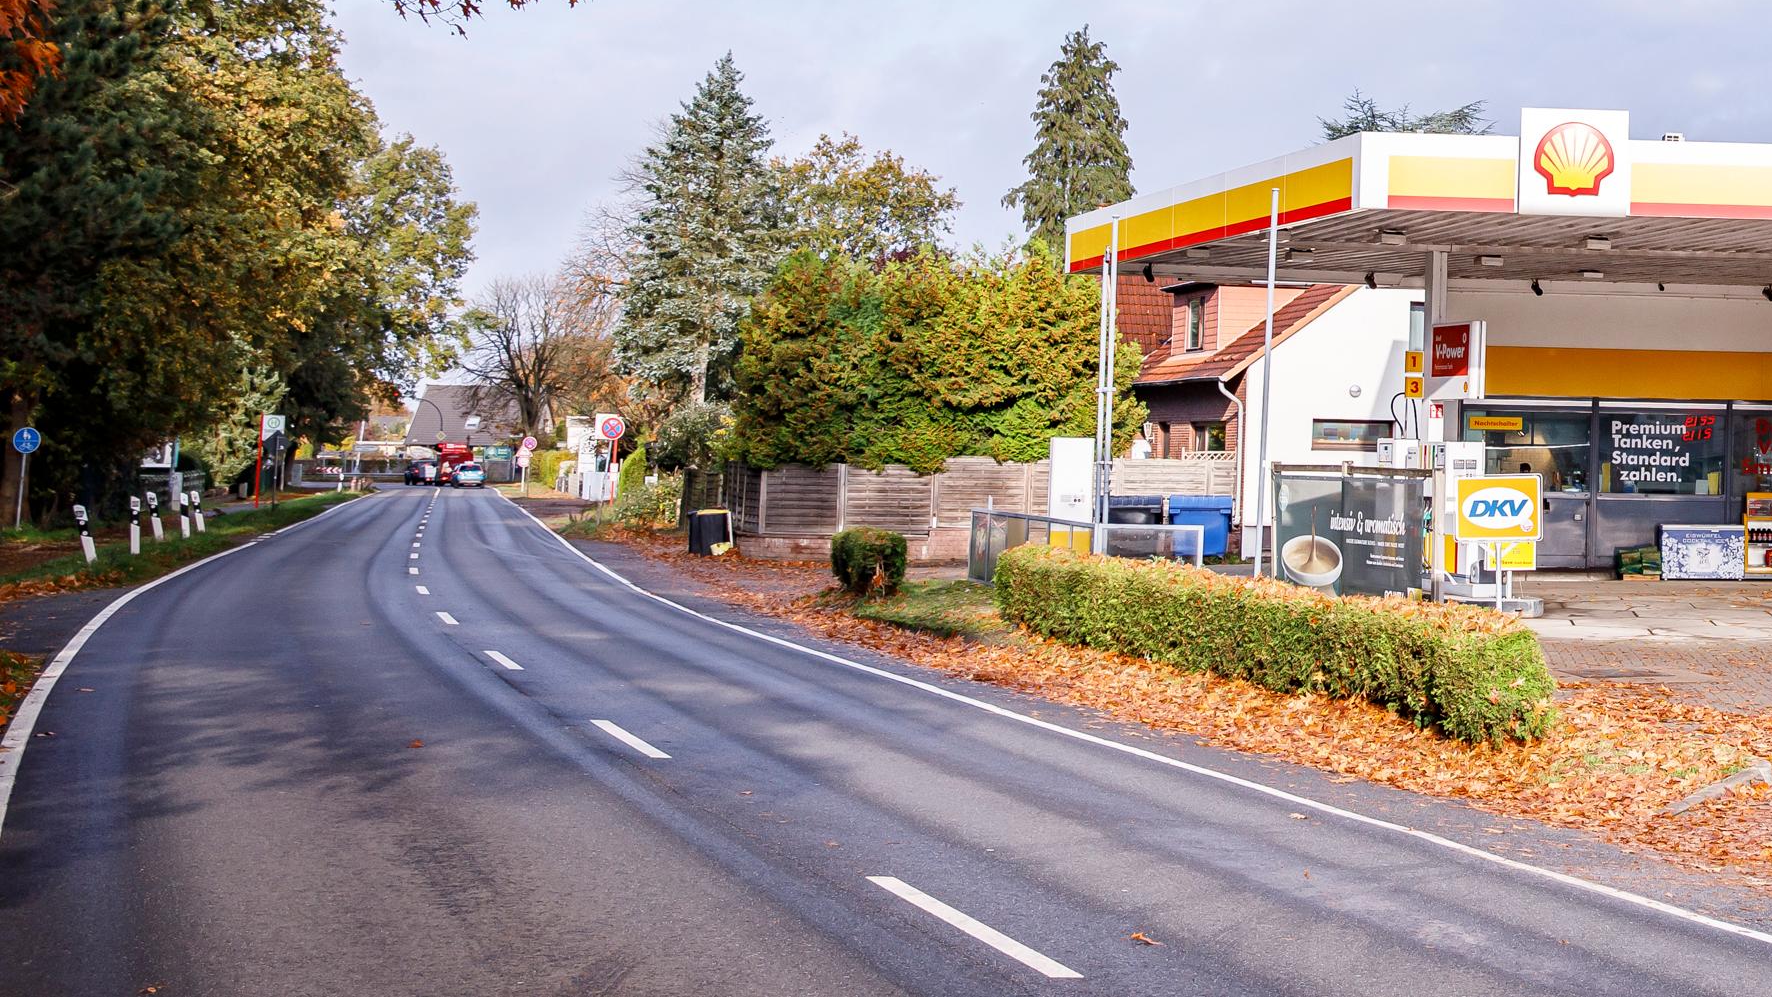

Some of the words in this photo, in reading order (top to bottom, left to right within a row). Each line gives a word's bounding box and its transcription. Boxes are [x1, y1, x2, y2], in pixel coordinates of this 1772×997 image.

[1435, 344, 1465, 359] V-Power
[1411, 356, 1416, 367] 1
[1410, 381, 1419, 393] 3
[1611, 420, 1687, 435] Premium
[1611, 434, 1681, 452] Tanken,
[1611, 451, 1690, 467] Standard
[1619, 467, 1682, 482] zahlen.
[1468, 499, 1529, 518] DKV
[1330, 509, 1356, 532] intensiv
[1356, 511, 1363, 535] &
[1364, 512, 1406, 536] aromatisch
